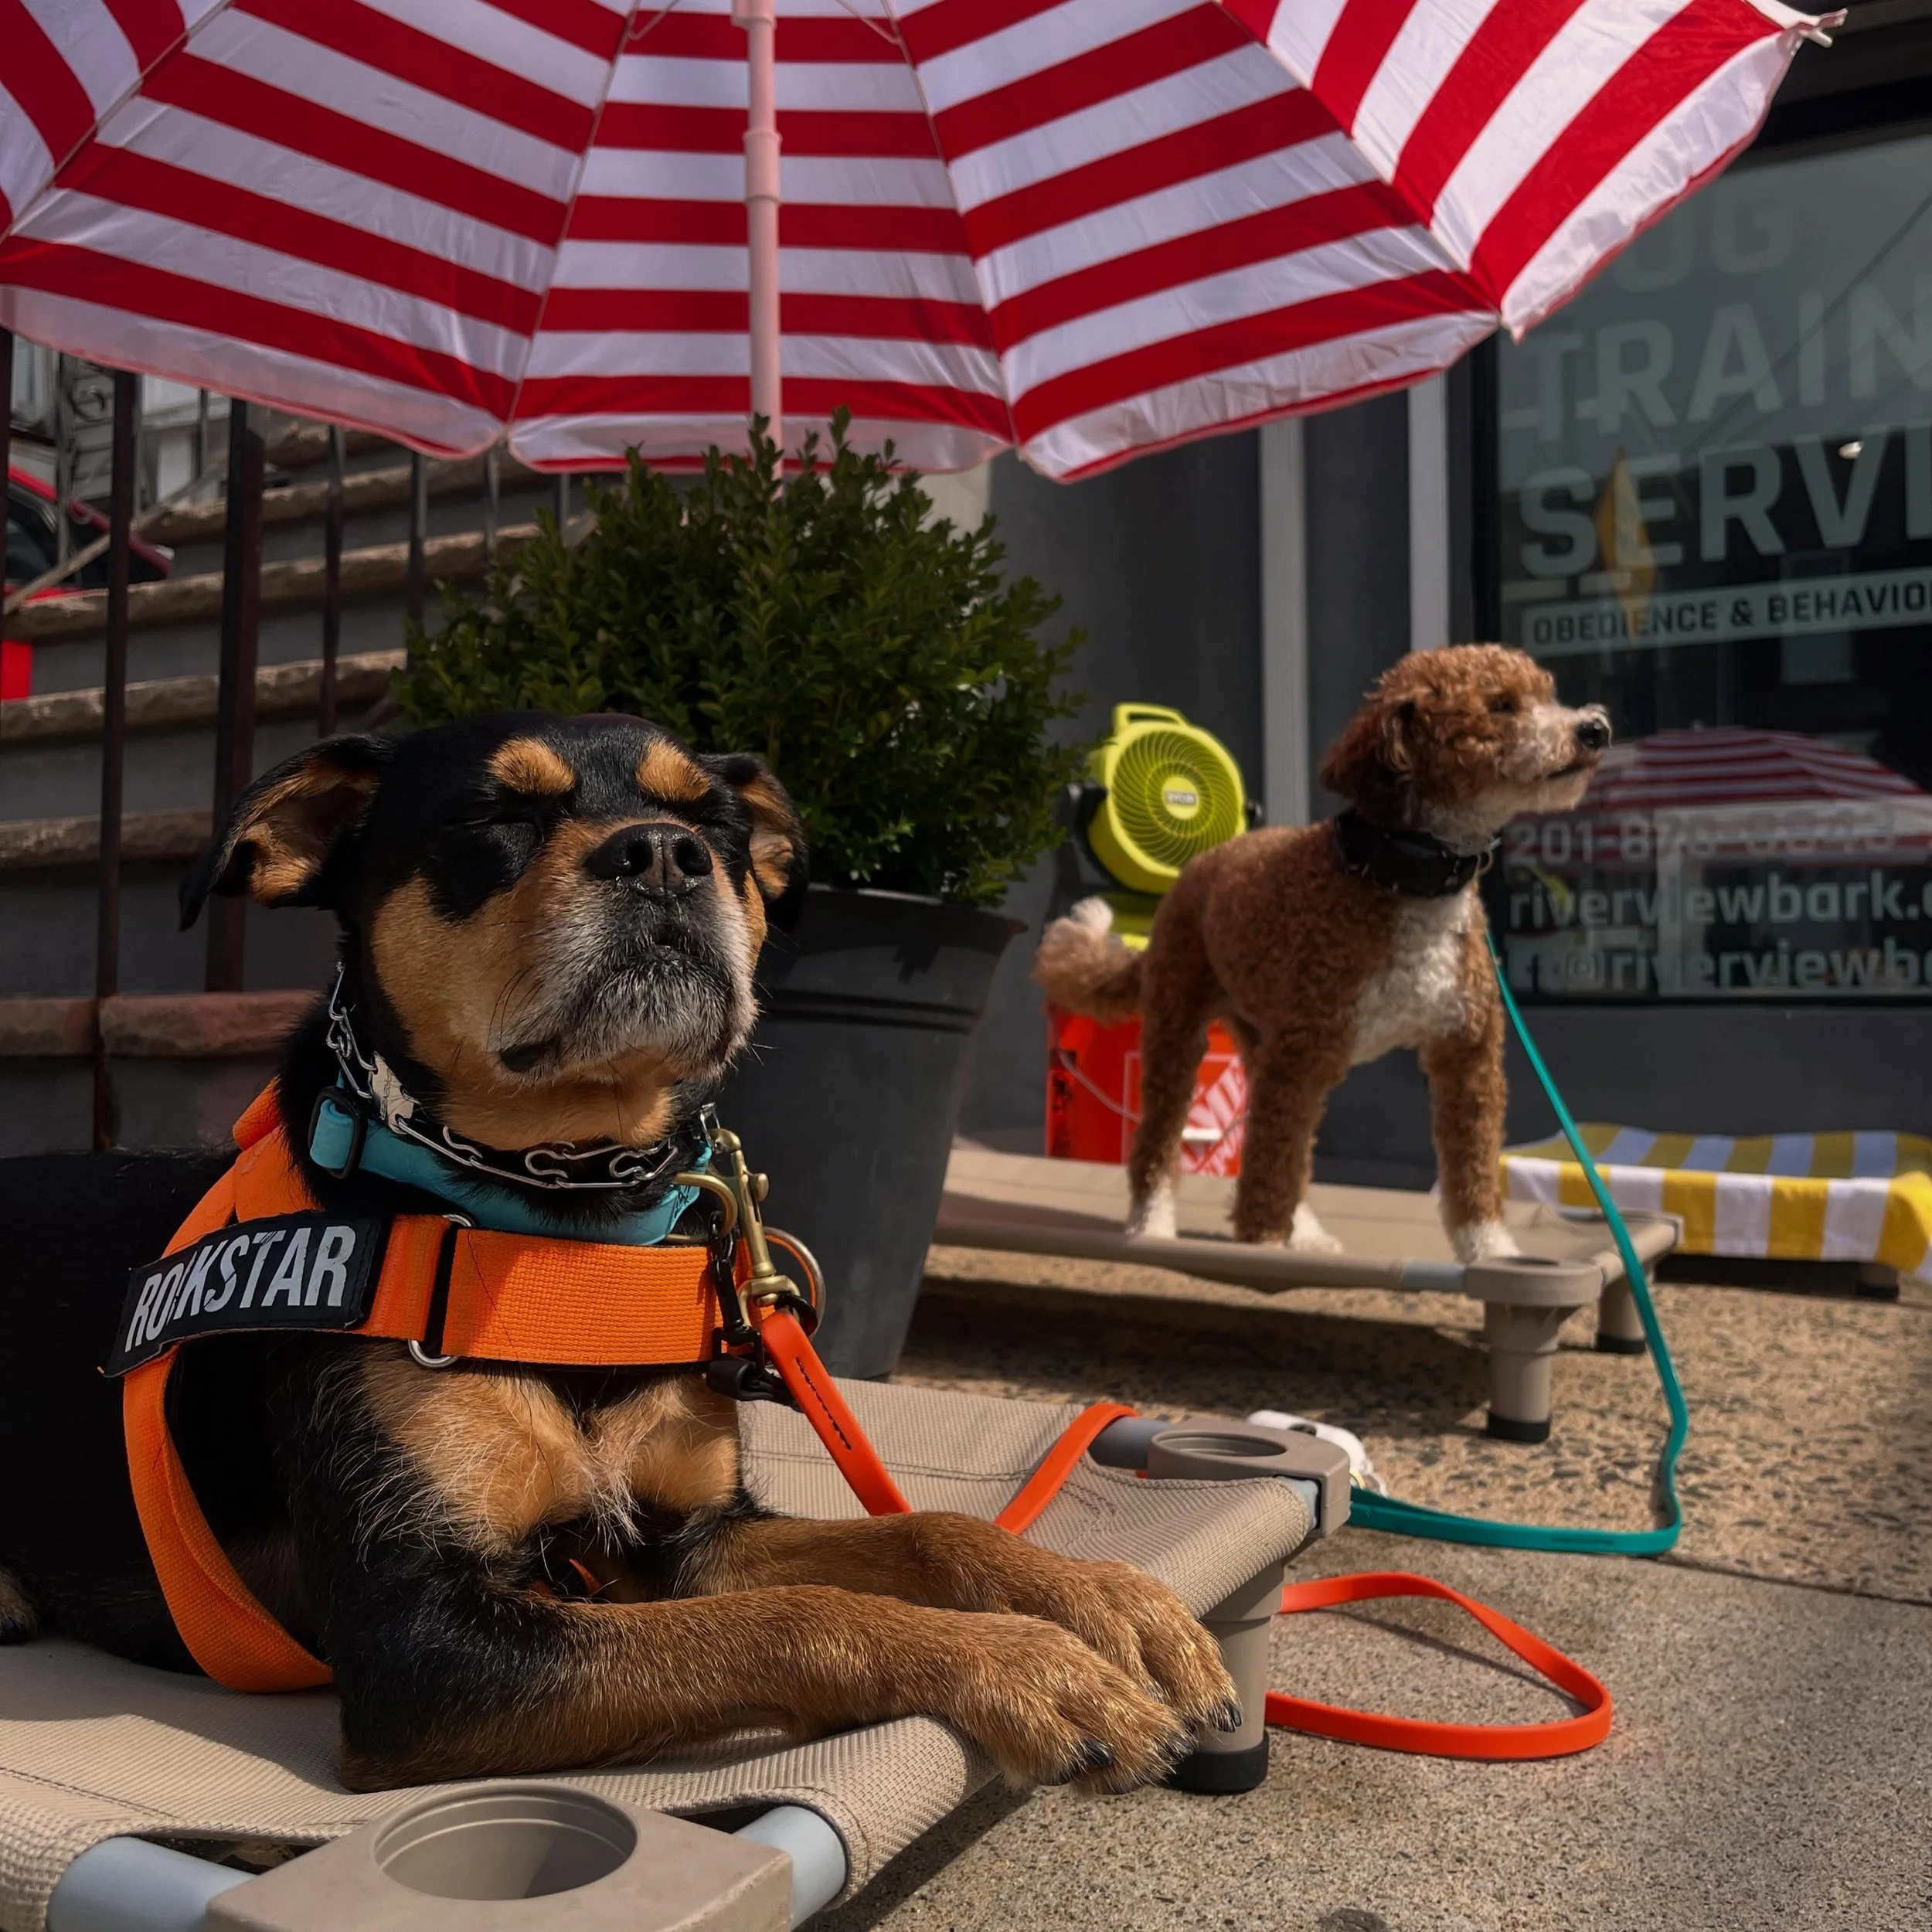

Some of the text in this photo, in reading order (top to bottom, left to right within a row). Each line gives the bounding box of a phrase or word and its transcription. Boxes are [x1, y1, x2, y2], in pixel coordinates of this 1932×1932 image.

[1533, 579, 1932, 646] OBEDIENCE & BEHAVIO
